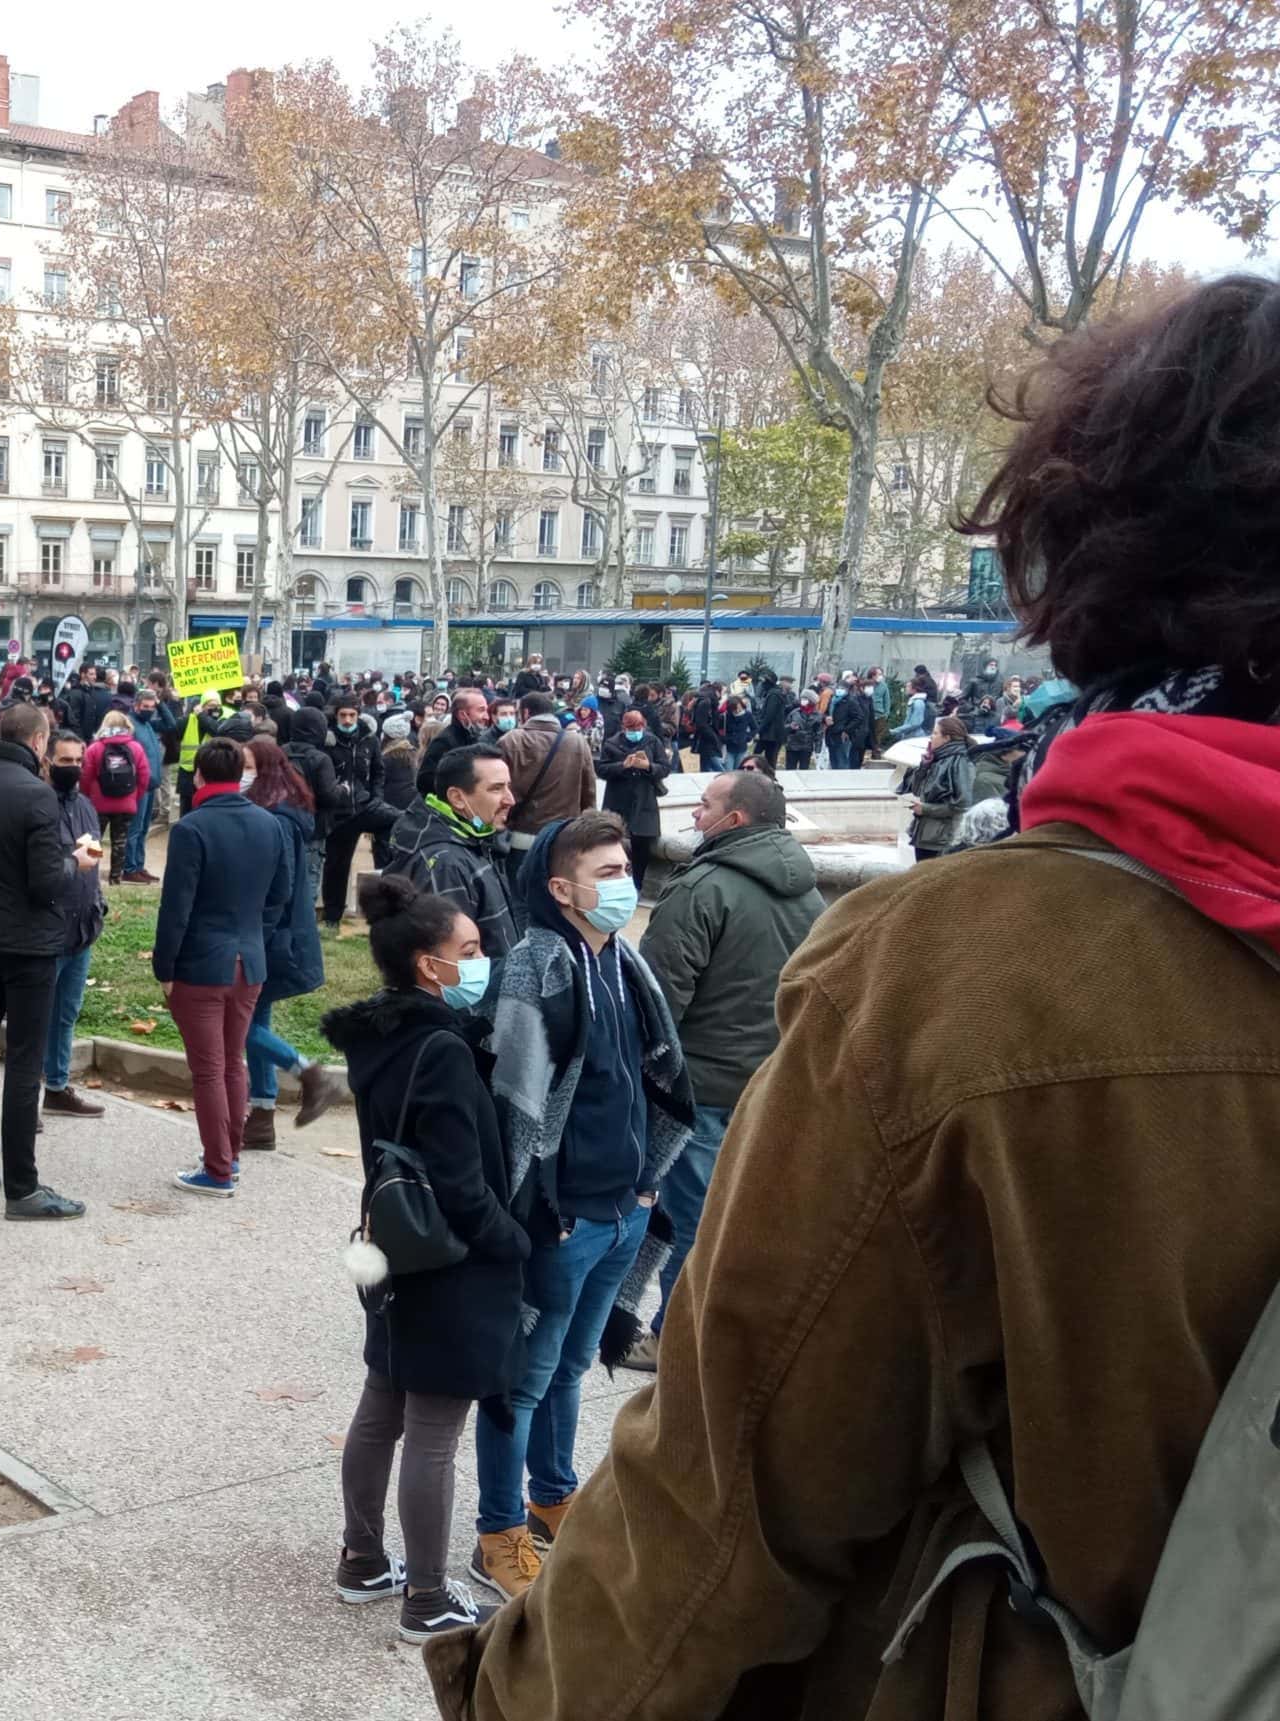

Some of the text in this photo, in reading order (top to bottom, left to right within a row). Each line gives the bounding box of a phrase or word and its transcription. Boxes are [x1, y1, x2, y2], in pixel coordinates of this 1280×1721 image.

[170, 635, 234, 656] ON VEUT UN
[172, 649, 235, 668] REFERENDUM
[180, 678, 197, 687] DANS
[200, 675, 208, 684] LE
